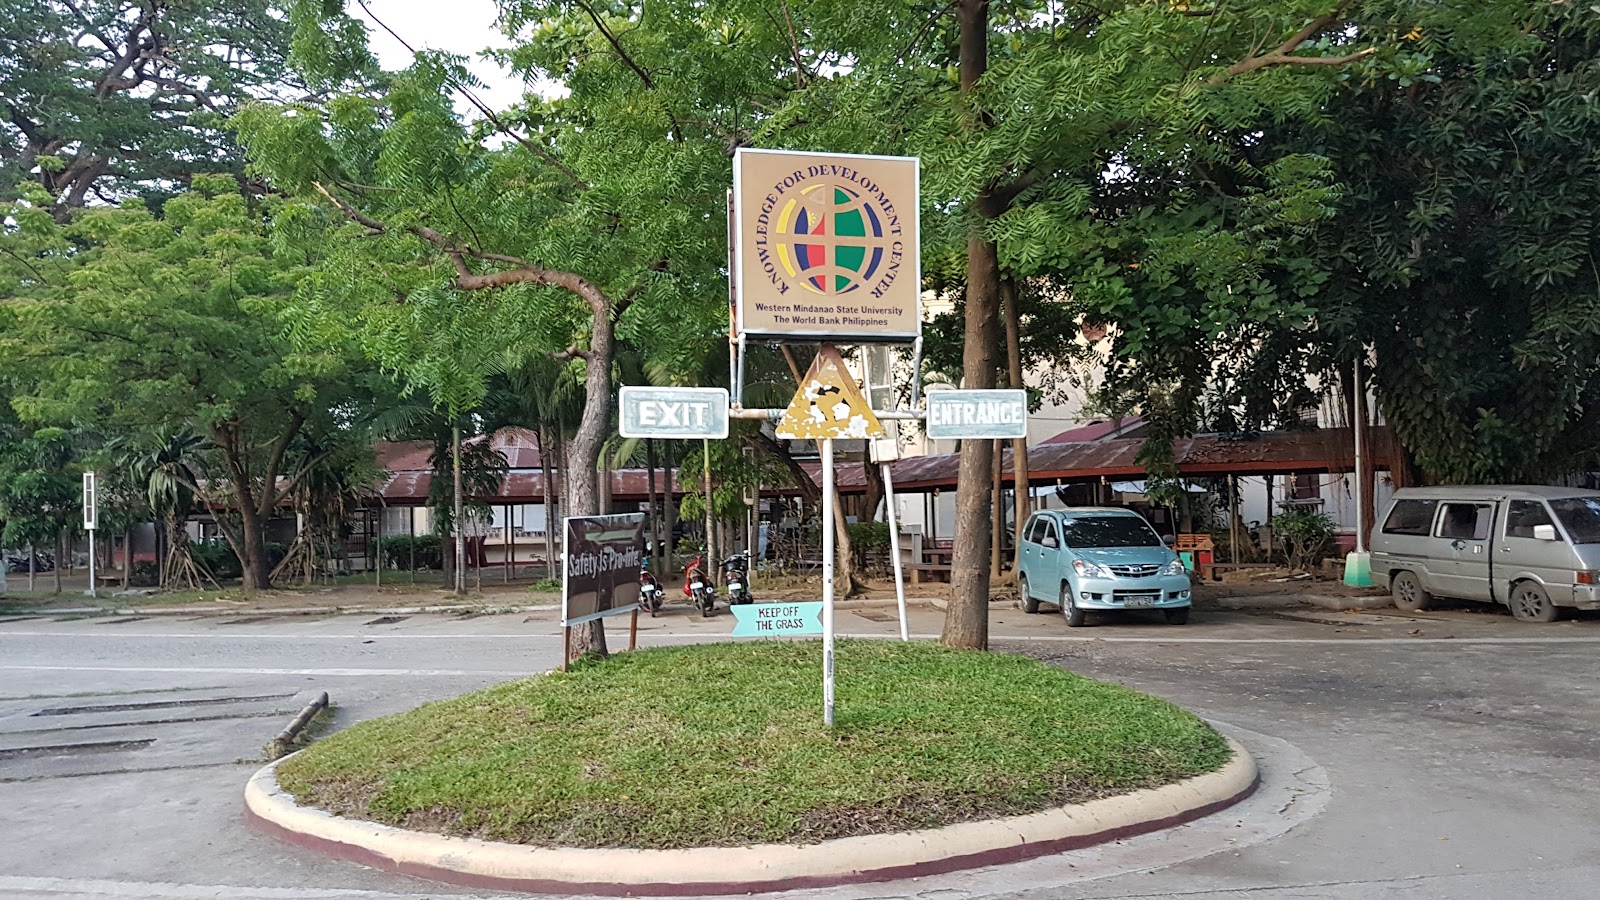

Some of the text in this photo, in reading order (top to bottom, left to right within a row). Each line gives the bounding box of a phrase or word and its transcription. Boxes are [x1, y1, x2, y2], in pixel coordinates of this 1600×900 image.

[756, 164, 903, 298] KNOWLEDGE FOR DEVELOPMENT CENTER
[755, 303, 903, 316] Western Mindanao State University
[774, 315, 888, 327] The World Bank Philippines
[639, 400, 709, 426] EXIT
[930, 402, 1023, 425] ENTRANCE
[569, 552, 597, 579] Safety
[758, 606, 799, 618] KEEP OFF
[755, 618, 804, 631] THE GRASS
